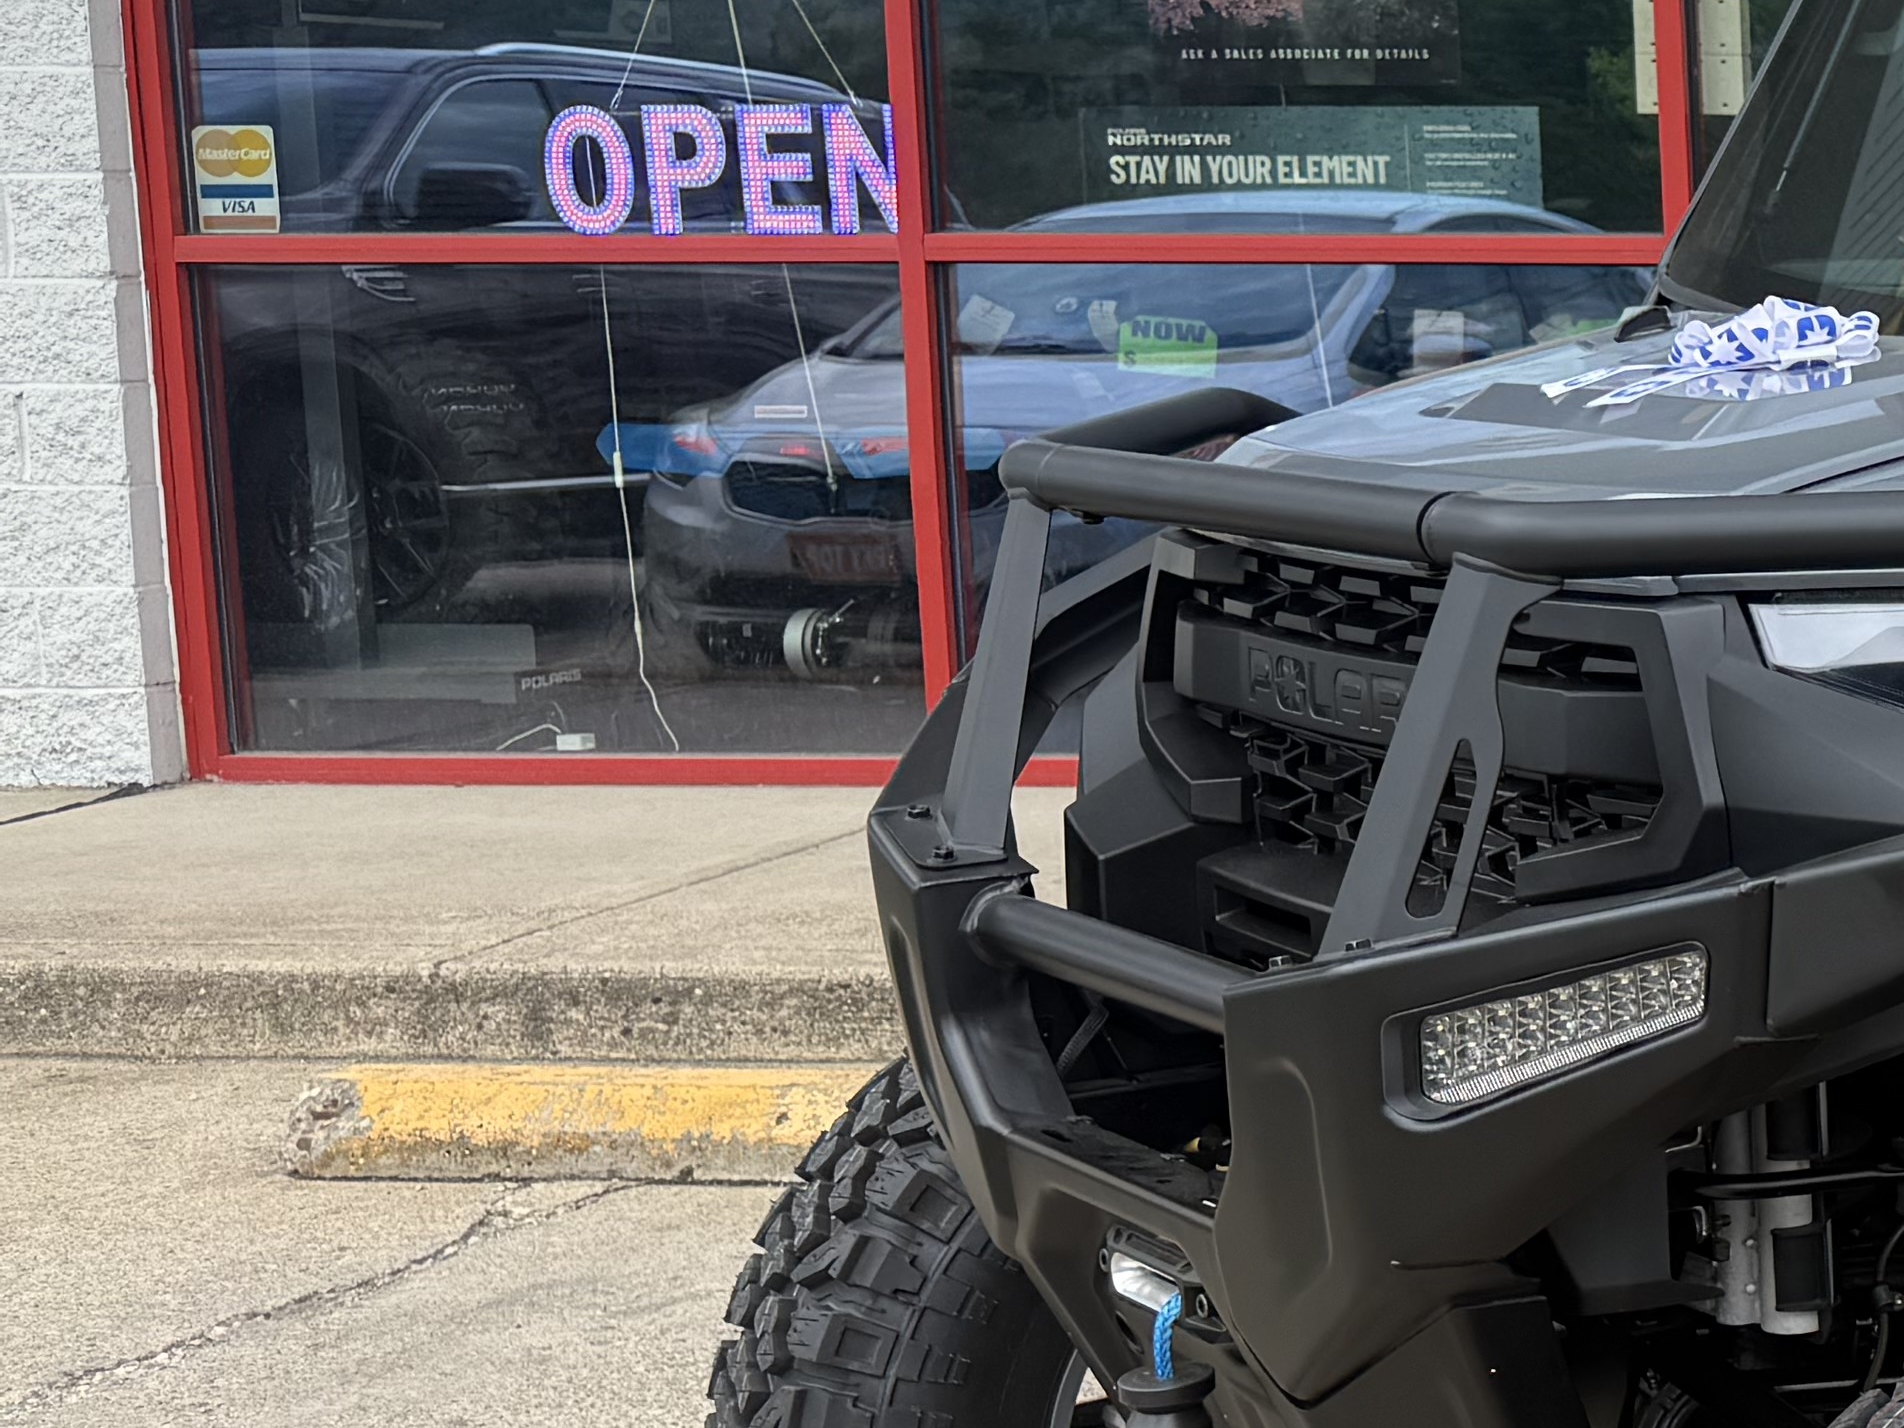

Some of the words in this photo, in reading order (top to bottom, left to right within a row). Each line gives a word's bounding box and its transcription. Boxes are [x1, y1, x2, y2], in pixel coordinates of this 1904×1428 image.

[1107, 133, 1231, 148] NORTHSTAR
[198, 147, 271, 161] MasterCard
[543, 103, 898, 235] OPEN
[1108, 155, 1169, 185] STAY
[1175, 155, 1202, 185] IN
[1206, 155, 1273, 185] YOUR
[1278, 154, 1391, 185] ELEMENT
[222, 200, 256, 214] VISA
[1131, 320, 1206, 344] NOW
[521, 668, 582, 691] POLARIS
[1248, 646, 1409, 732] POLAR
